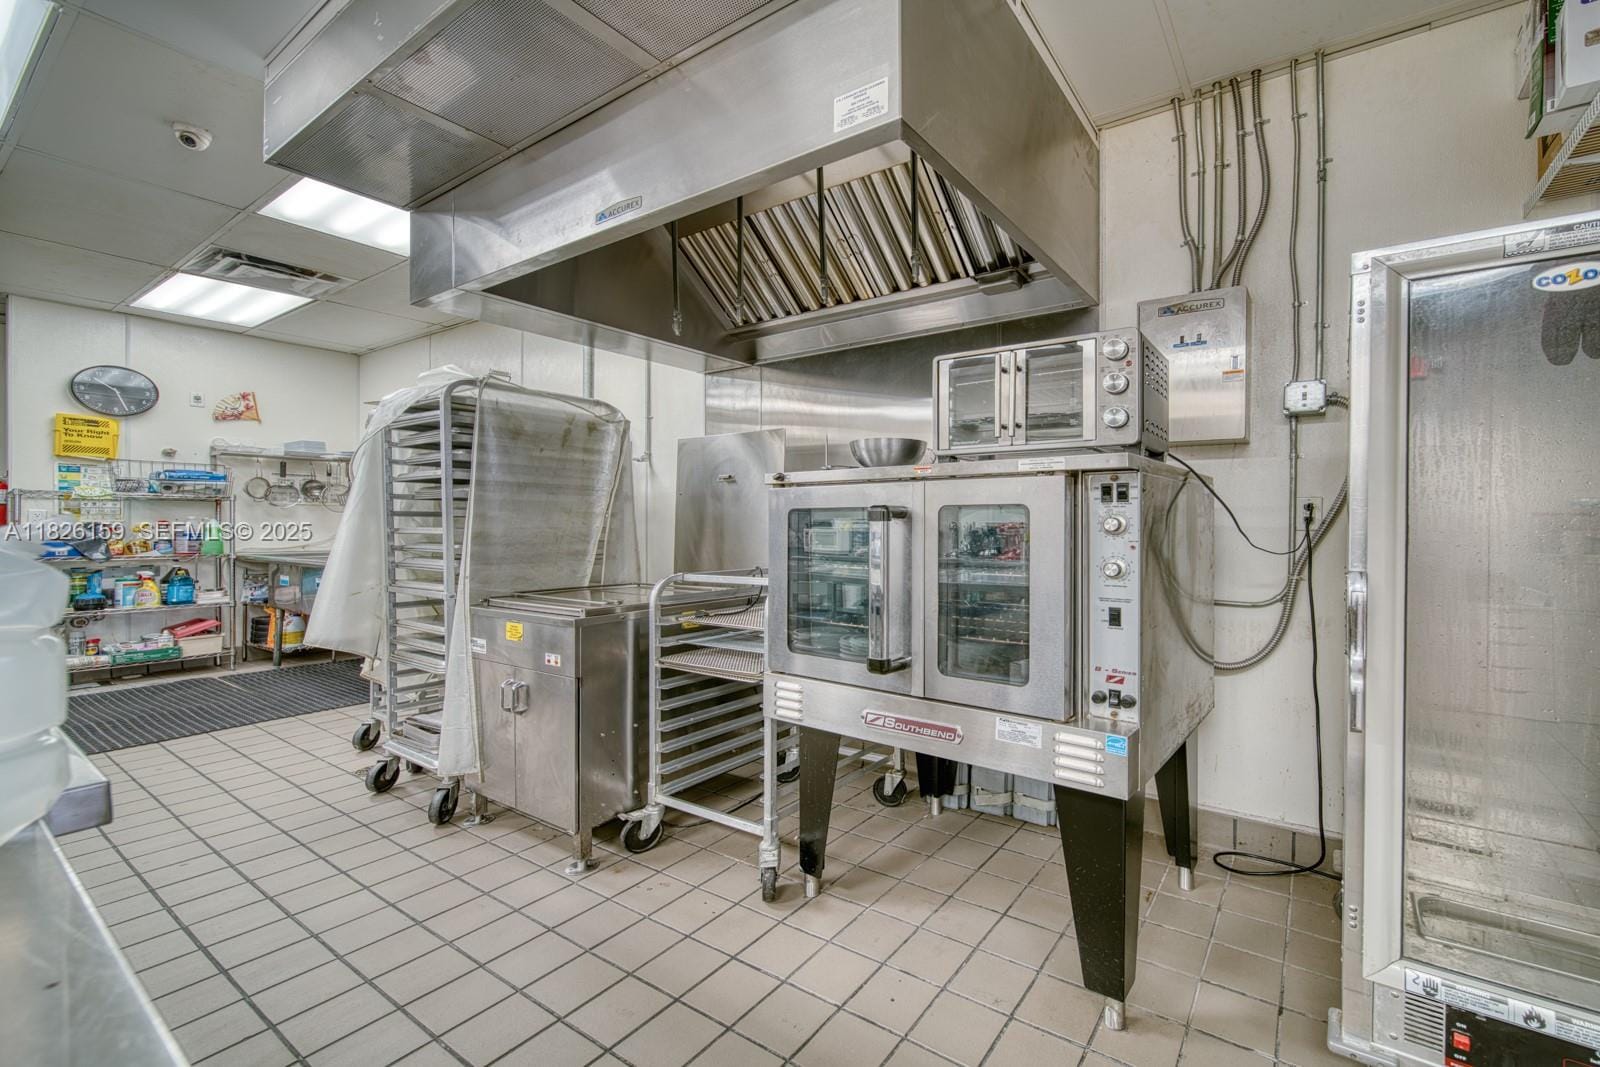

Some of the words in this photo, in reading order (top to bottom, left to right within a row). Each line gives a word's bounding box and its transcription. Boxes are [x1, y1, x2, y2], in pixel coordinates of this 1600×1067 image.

[1176, 300, 1221, 313] ACCUREX
[86, 428, 110, 436] Right
[884, 718, 955, 740] SOUTHBEND
